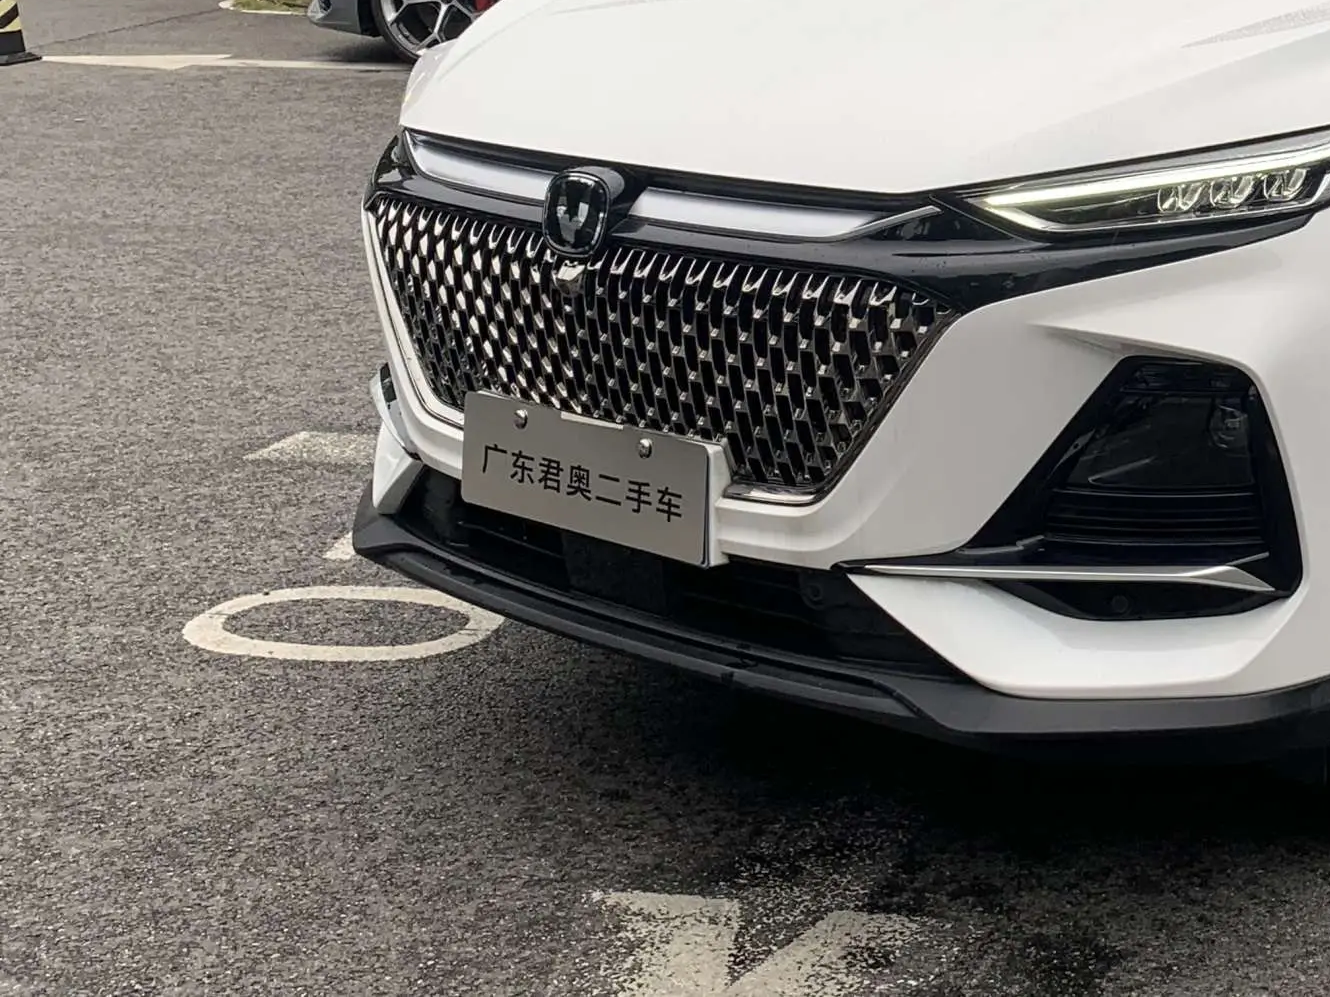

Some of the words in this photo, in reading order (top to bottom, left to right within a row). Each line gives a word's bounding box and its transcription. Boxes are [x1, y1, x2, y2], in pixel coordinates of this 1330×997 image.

[482, 443, 684, 523] 广东君奥二手车
